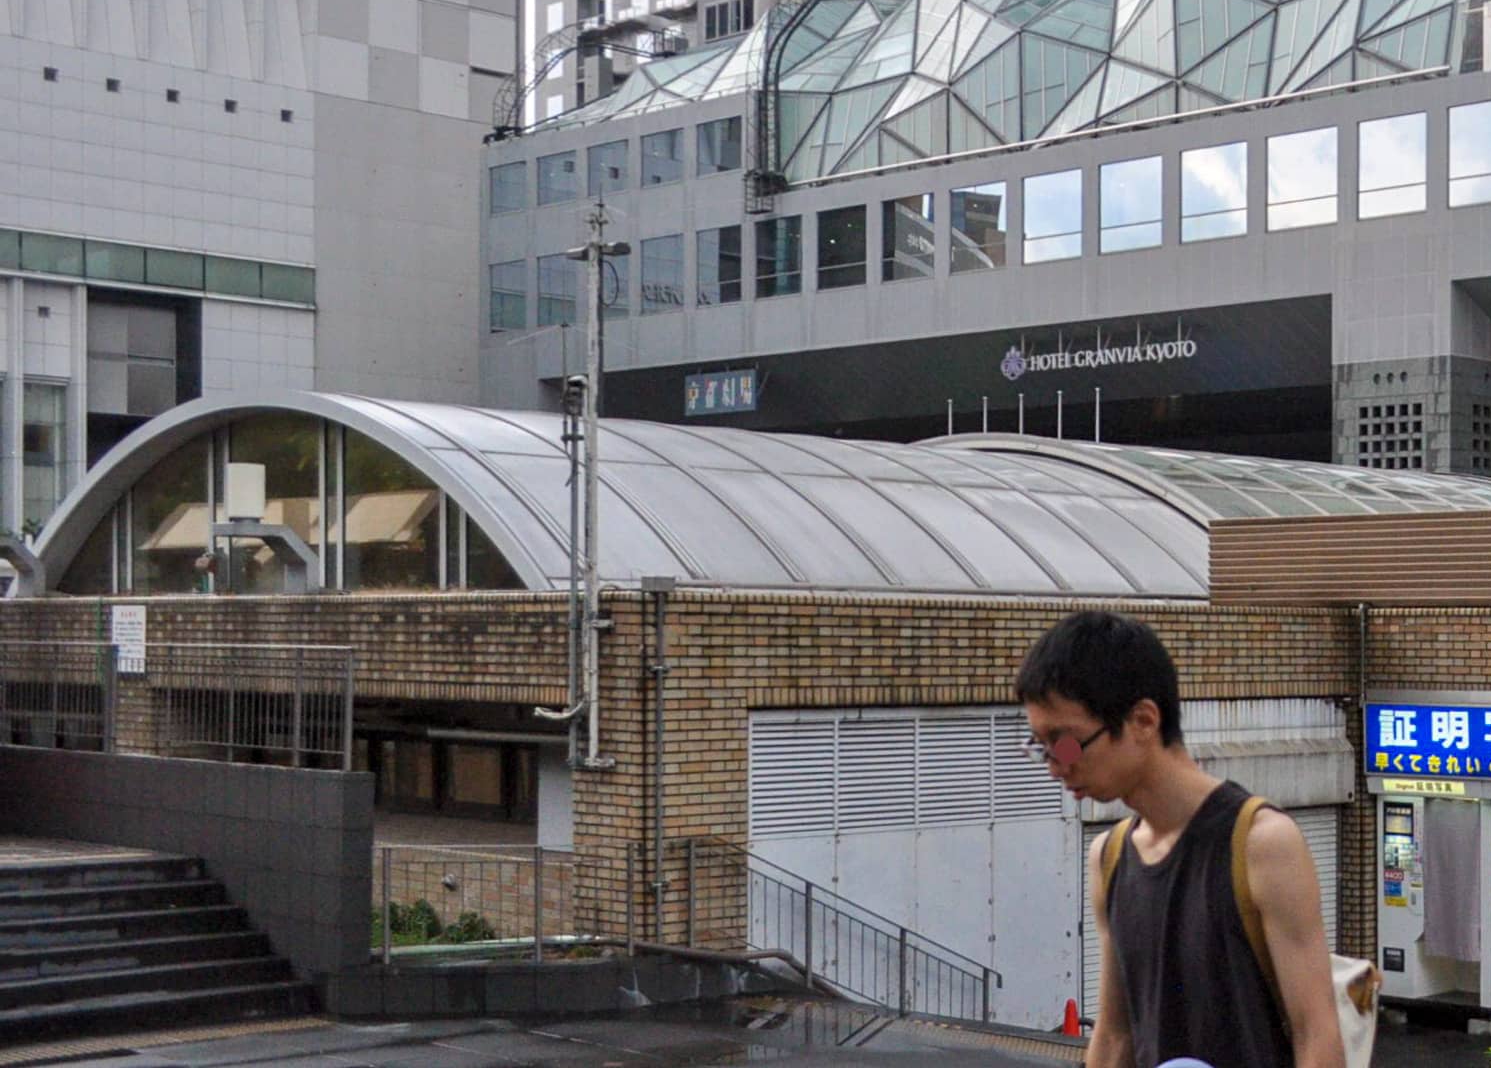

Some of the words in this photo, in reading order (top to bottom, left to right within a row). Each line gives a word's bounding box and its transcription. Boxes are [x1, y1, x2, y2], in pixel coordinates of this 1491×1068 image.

[1030, 352, 1072, 371] HOTEL
[1074, 345, 1143, 368] GRANVIA
[1142, 340, 1197, 363] KYOTO
[1375, 752, 1481, 774] 早くてきれい
